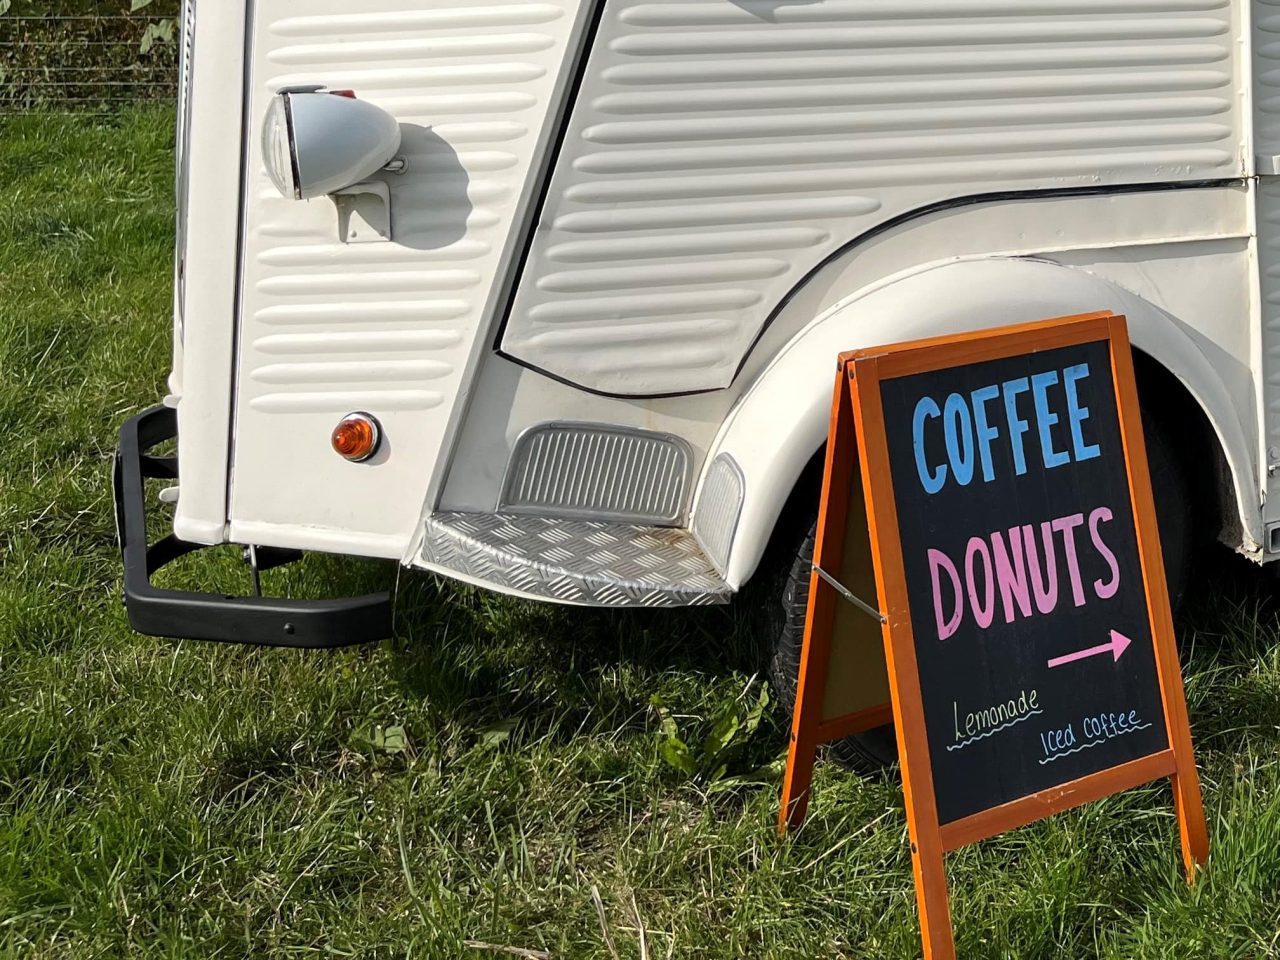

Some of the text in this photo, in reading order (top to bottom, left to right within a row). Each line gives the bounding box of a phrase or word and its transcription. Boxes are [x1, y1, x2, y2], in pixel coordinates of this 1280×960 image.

[912, 363, 1100, 494] COFFEE
[928, 506, 1120, 640] DONUTS
[954, 689, 1039, 740] Lemonade
[1040, 724, 1076, 755] Iced
